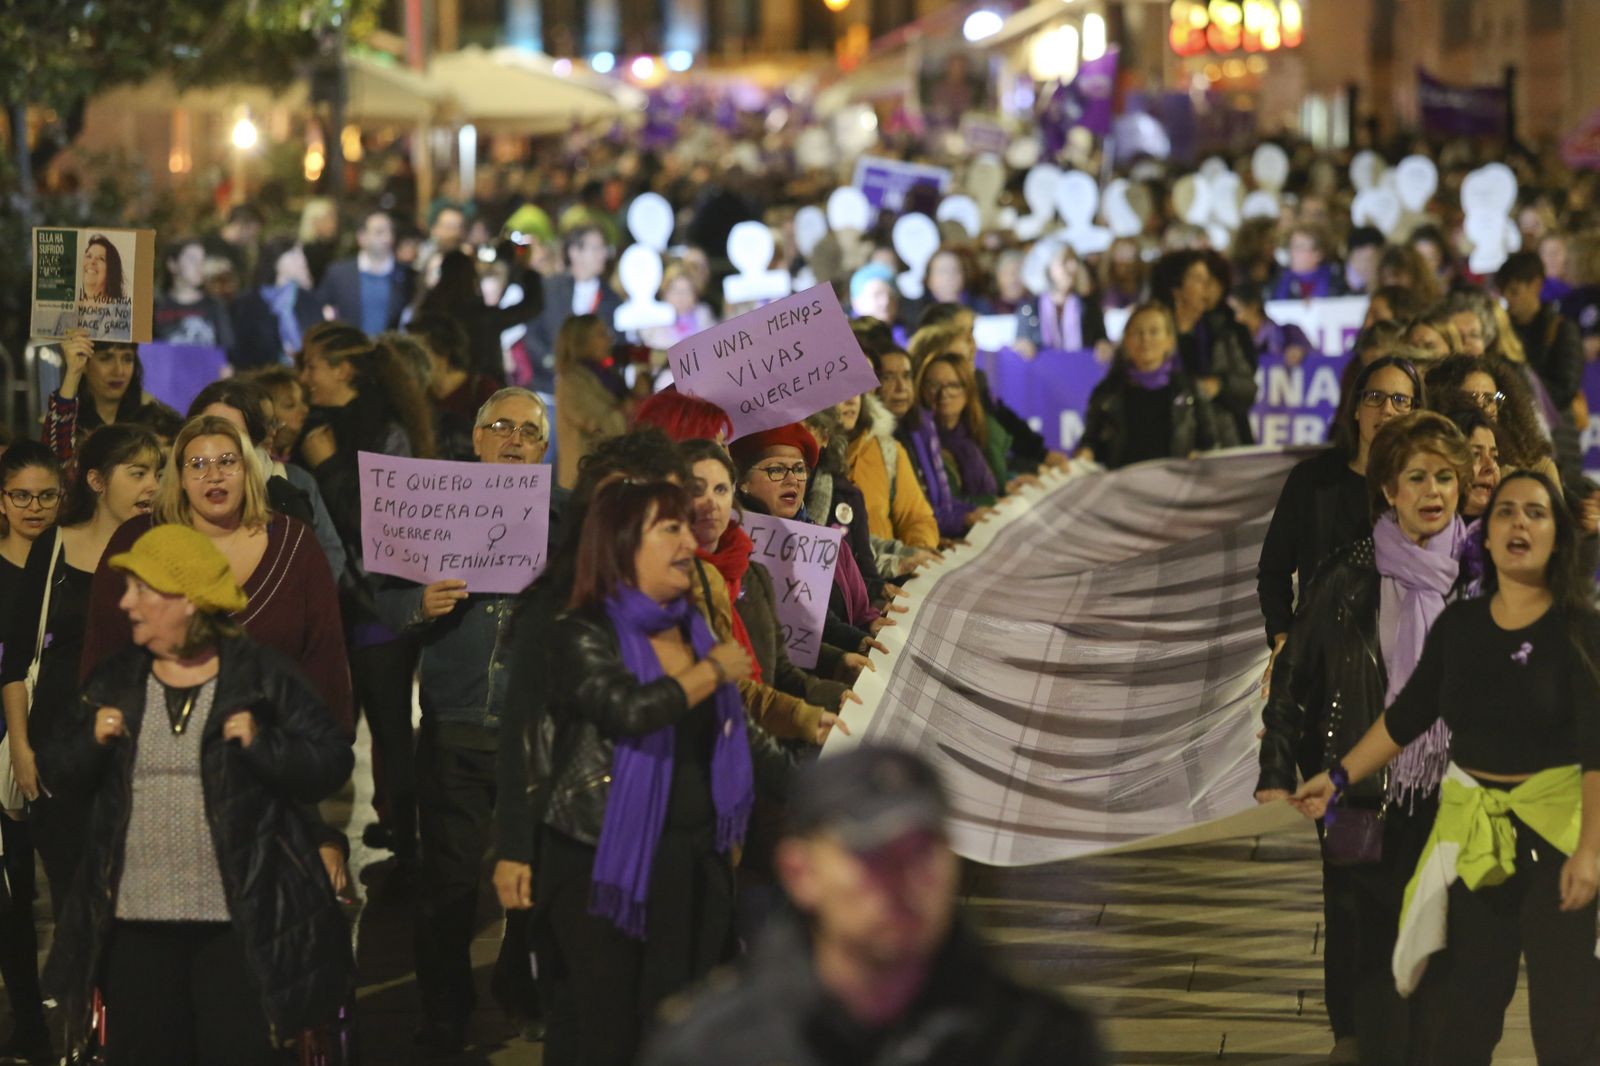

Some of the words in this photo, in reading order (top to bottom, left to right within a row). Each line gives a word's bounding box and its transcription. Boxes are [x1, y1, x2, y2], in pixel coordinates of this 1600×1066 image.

[39, 232, 53, 243] ELLA
[54, 233, 64, 243] HA
[39, 244, 64, 255] SUFRIDO
[115, 309, 130, 319] NO
[680, 348, 700, 380] NI
[713, 330, 753, 359] UNA
[767, 300, 823, 335] MENOS
[726, 341, 804, 388] VIVAS
[740, 356, 849, 414] QUEREMOS
[370, 468, 397, 489] TE
[406, 473, 473, 492] QUIERO
[485, 474, 539, 490] LIBRE
[374, 496, 504, 520] EMPODERADA
[523, 506, 532, 520] Y
[382, 524, 452, 541] GUERRERA
[372, 538, 395, 560] YO
[402, 548, 430, 572] SOY
[440, 552, 540, 572] FEMINISTA!
[782, 577, 812, 604] YA
